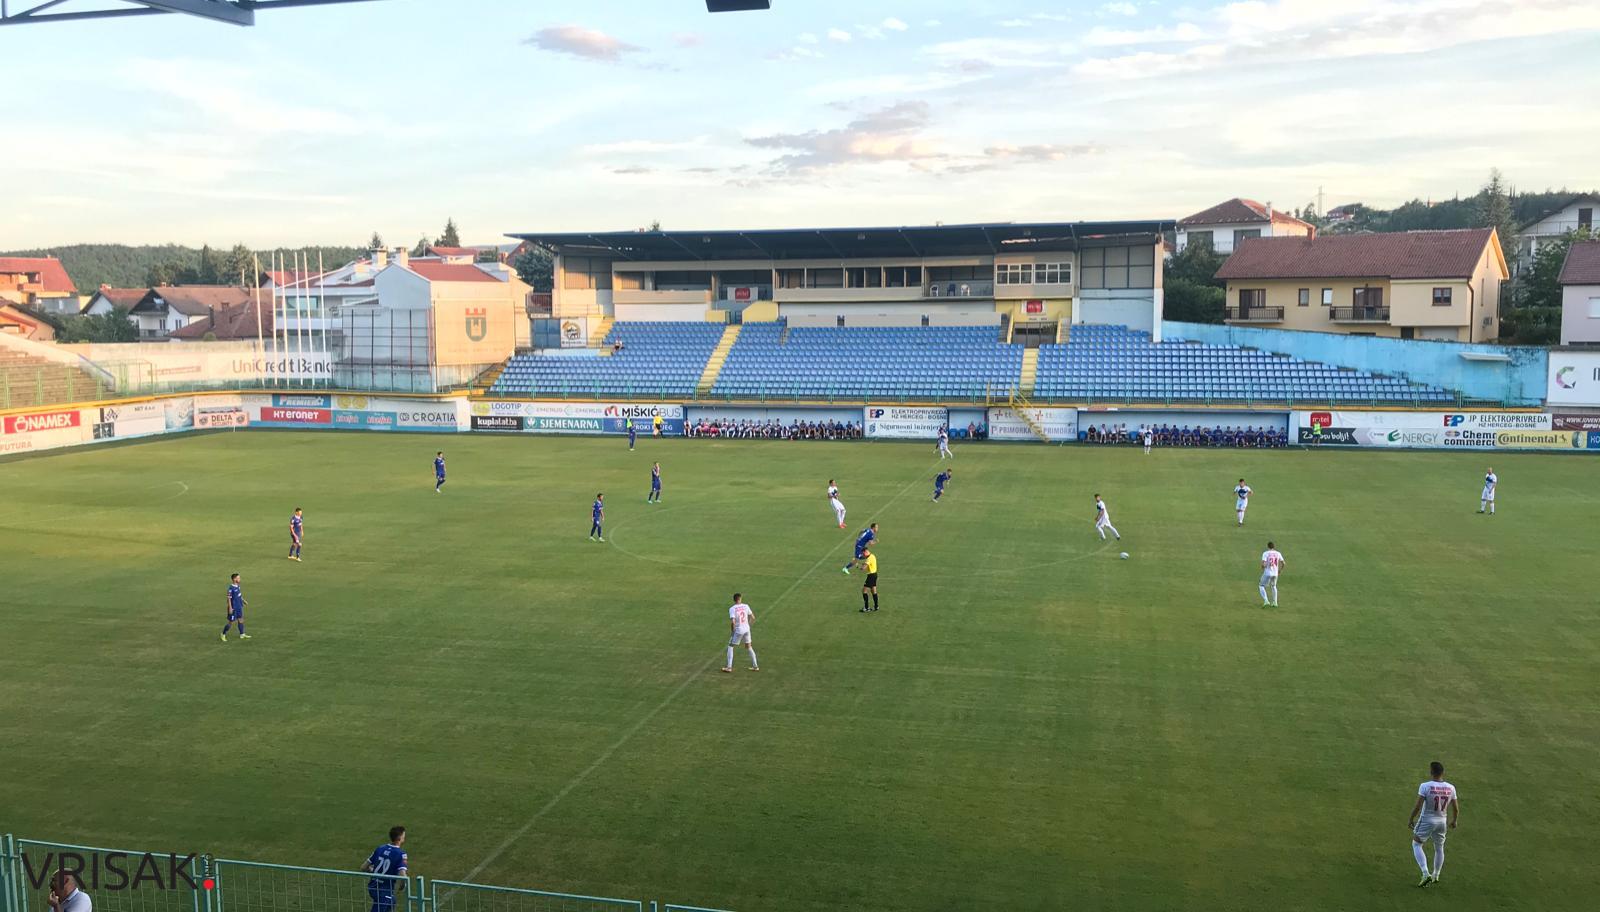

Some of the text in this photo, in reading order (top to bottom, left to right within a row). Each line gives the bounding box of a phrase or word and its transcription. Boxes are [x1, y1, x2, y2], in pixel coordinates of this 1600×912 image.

[233, 358, 294, 374] UniCredt
[211, 414, 233, 422] DELTA
[413, 412, 456, 422] CROATIA
[1443, 415, 1465, 427] EP
[1468, 414, 1548, 423] JP ELEKTROPRIVREDA
[540, 419, 600, 430] SJEMENARNA
[879, 422, 913, 432] Sigurnosni
[1498, 433, 1558, 445] Continental
[1269, 557, 1278, 567] 24
[1433, 795, 1449, 812] 17
[374, 856, 391, 876] 79
